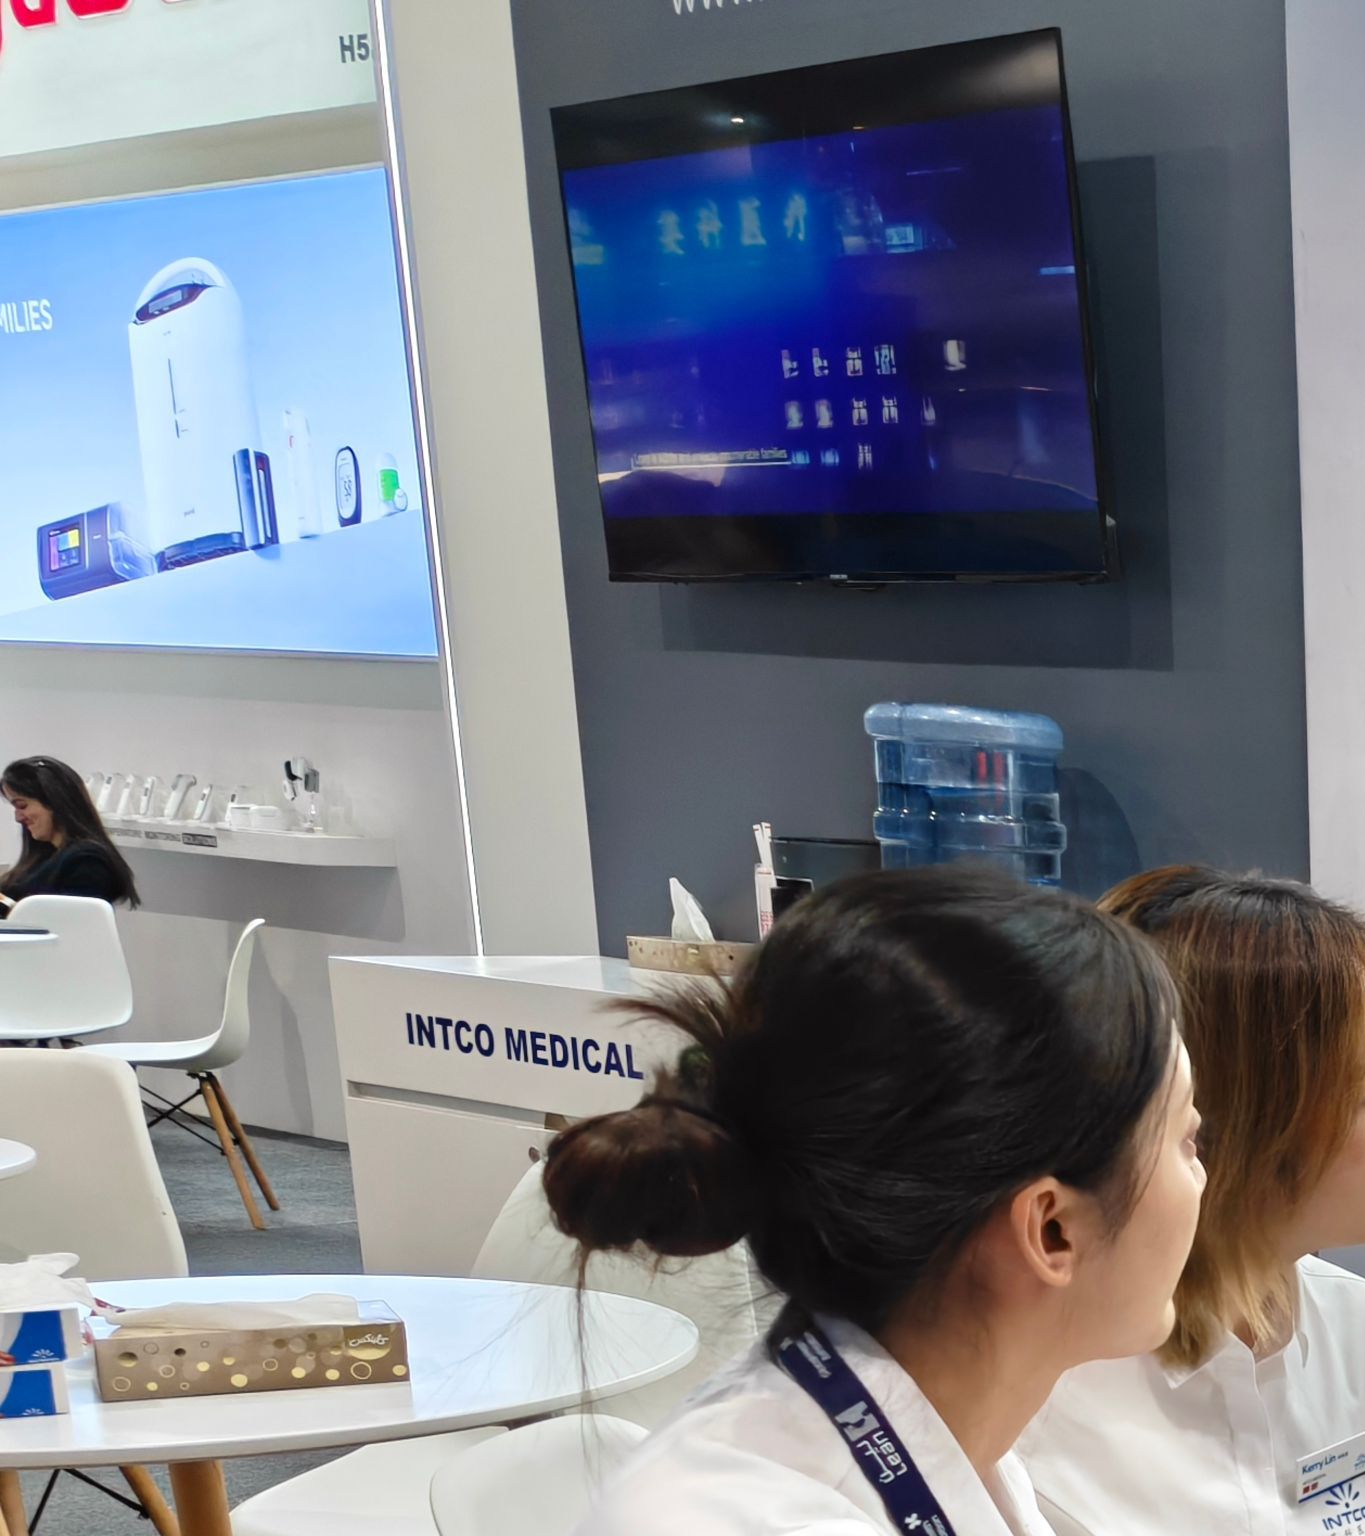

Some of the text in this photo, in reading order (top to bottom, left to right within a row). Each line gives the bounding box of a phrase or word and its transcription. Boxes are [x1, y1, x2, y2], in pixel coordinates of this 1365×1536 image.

[339, 34, 374, 63] H5
[405, 1012, 645, 1080] INTCO MEDICAL
[1301, 1460, 1324, 1475] Kerry
[1324, 1454, 1337, 1466] Lin
